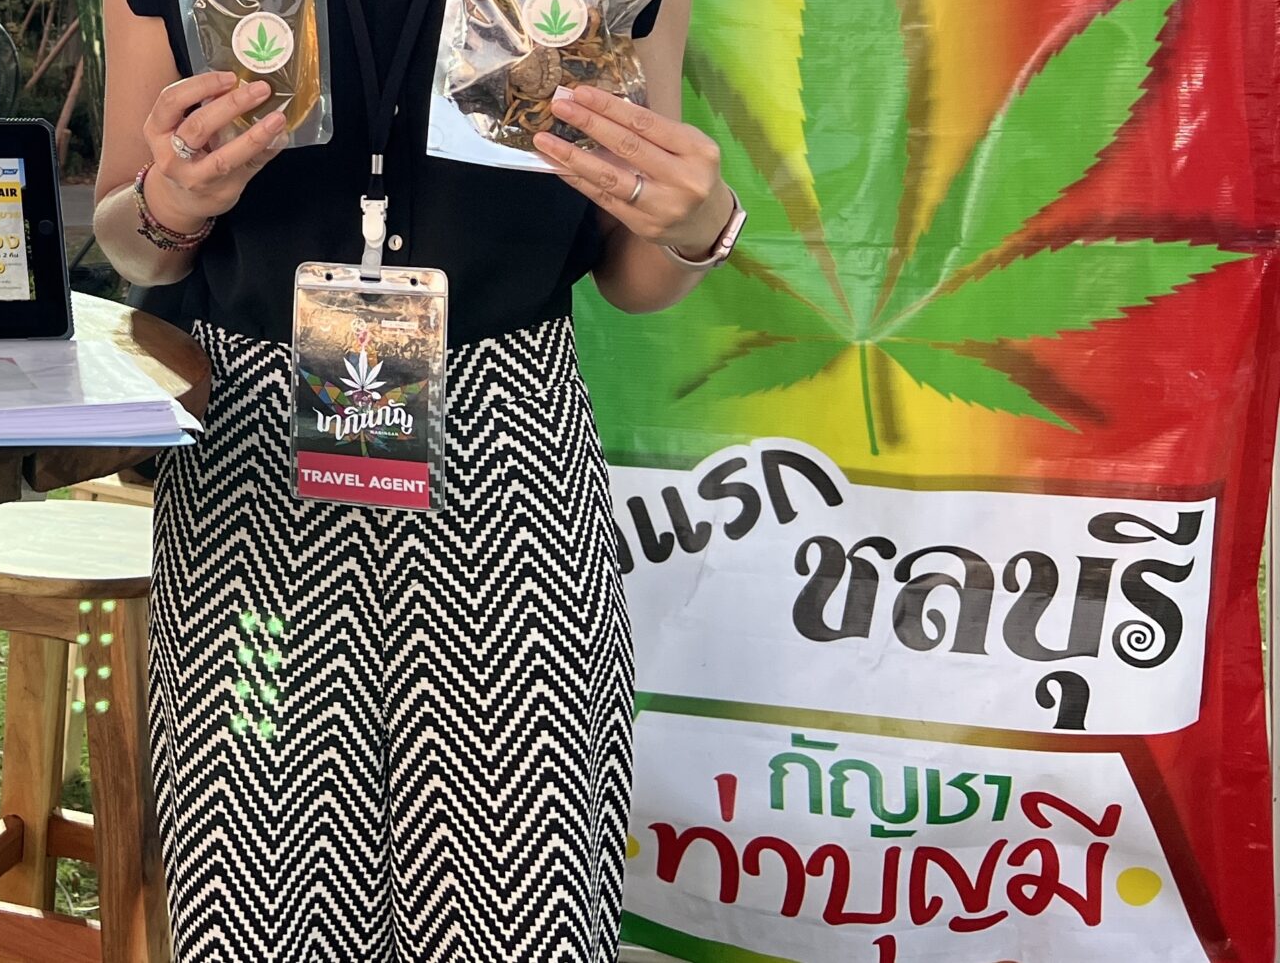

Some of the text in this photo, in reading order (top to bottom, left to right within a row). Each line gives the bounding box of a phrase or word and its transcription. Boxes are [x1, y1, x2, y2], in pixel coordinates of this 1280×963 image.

[300, 468, 427, 494] TRAVEL AGENT
[615, 449, 844, 575] แรก
[791, 509, 1206, 732] ชลบุรี
[768, 732, 1013, 839] กัญชา
[648, 773, 1123, 963] ท่าบุญมี
